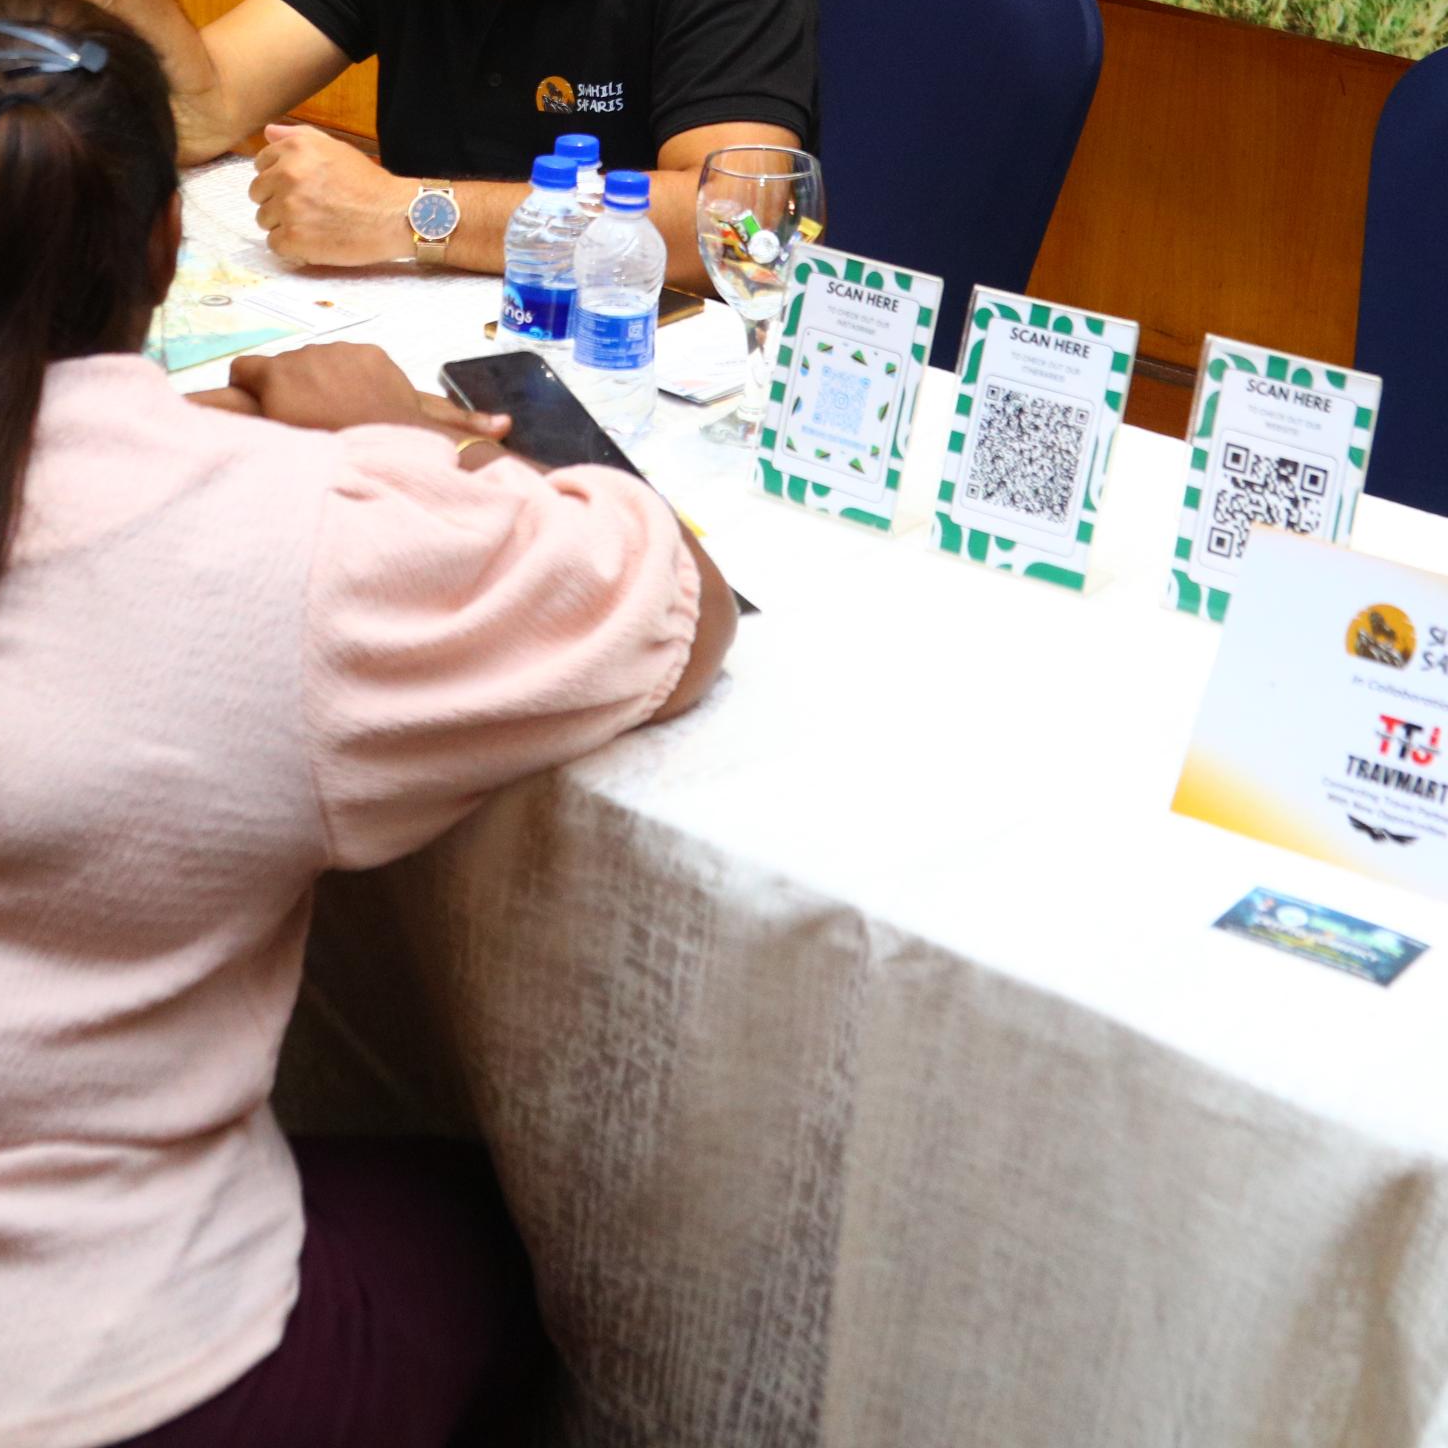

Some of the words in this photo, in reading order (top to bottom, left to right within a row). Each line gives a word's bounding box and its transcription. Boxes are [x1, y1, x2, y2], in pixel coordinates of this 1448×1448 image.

[576, 98, 624, 113] SAFARIS
[826, 280, 864, 303] SCAN
[865, 292, 900, 313] HERE
[1009, 327, 1051, 349] SCAN
[1054, 337, 1091, 360] HERE
[1246, 378, 1290, 403] SCAN
[1293, 391, 1333, 414] HERE
